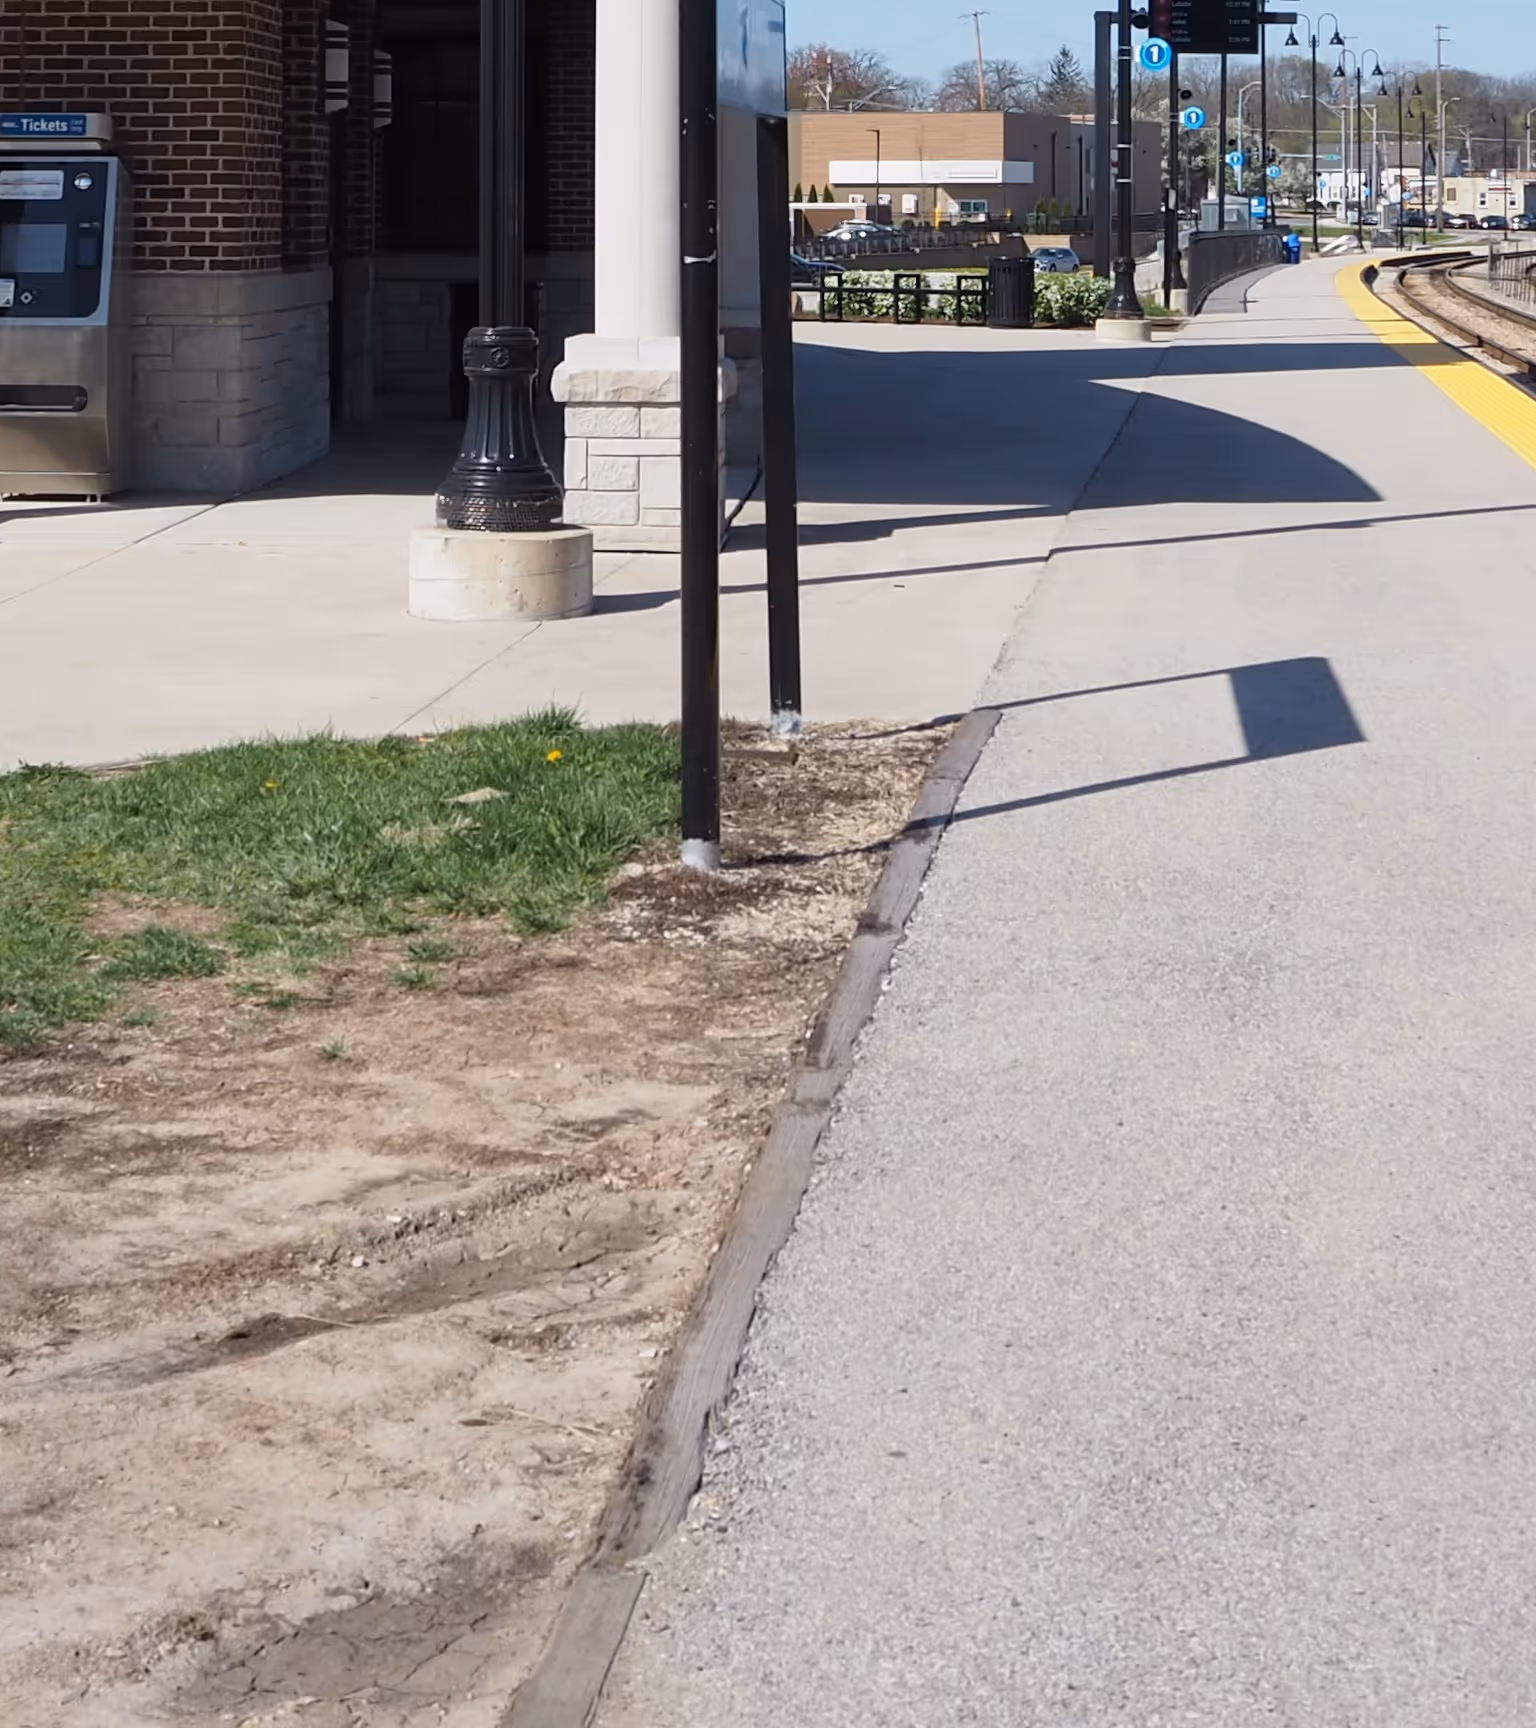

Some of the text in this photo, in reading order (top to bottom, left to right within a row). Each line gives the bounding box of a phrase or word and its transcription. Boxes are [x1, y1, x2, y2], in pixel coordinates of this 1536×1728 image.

[1149, 45, 1159, 63] 1
[20, 117, 69, 132] Tickets
[1189, 112, 1197, 124] 1
